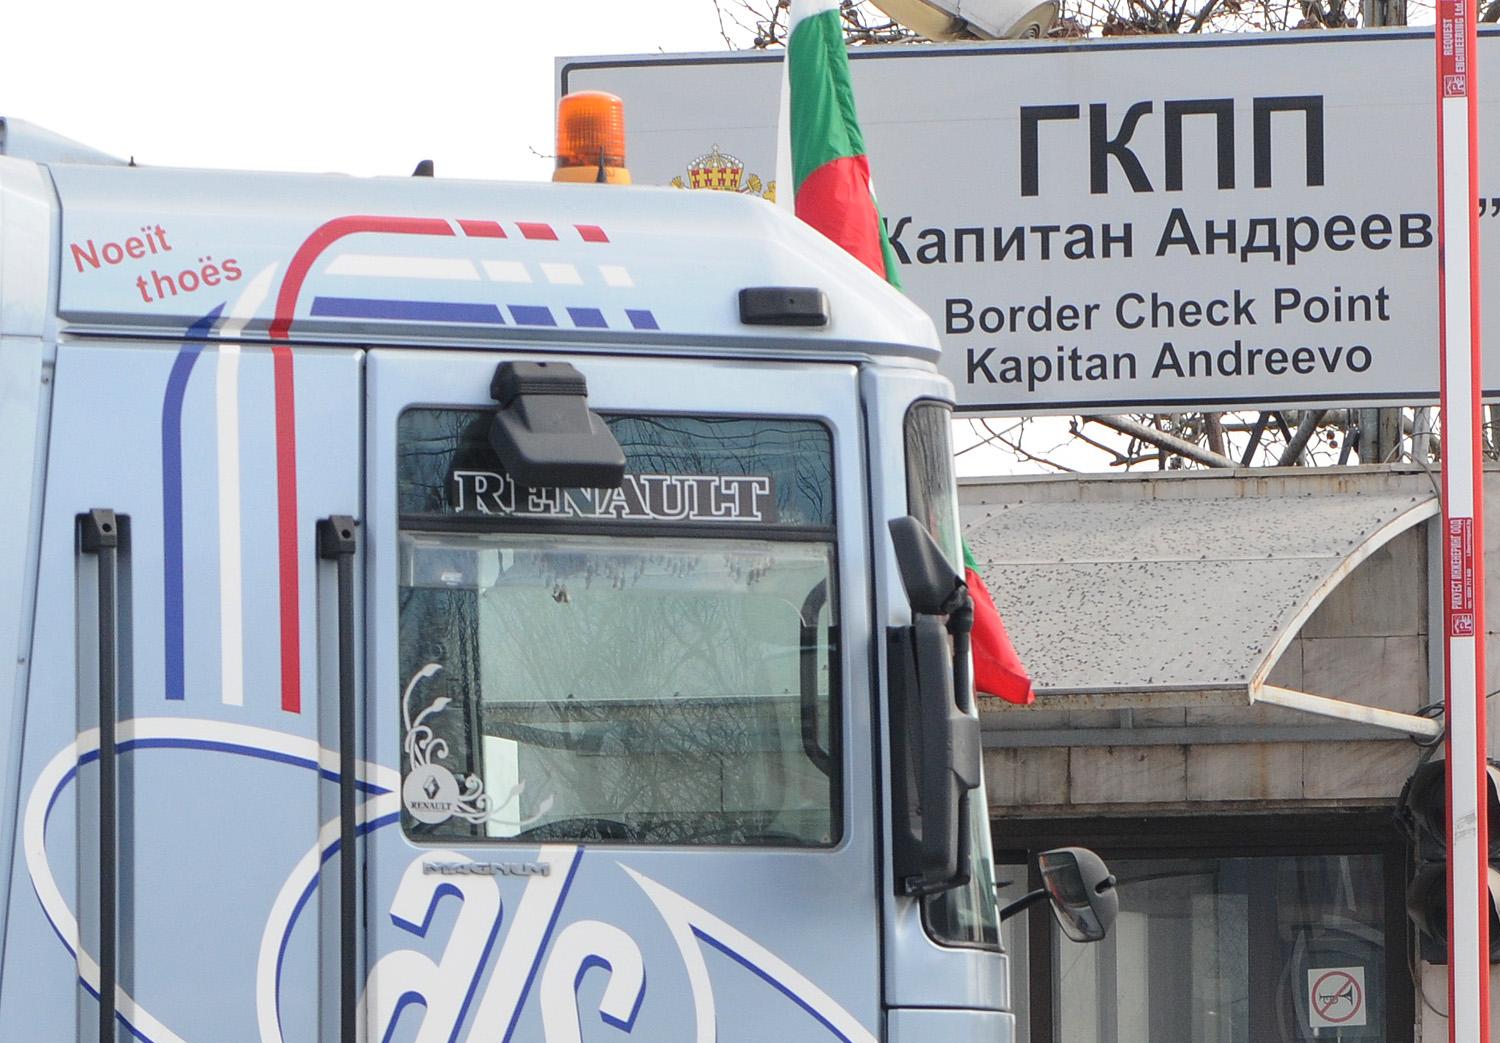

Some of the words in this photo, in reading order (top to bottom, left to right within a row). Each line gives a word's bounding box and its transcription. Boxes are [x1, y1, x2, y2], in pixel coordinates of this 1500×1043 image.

[1443, 18, 1453, 56] REQUEST
[1020, 94, 1325, 197] ГКПП
[70, 224, 172, 273] Noeït
[136, 255, 242, 304] thoës
[945, 296, 1101, 335] Border
[1115, 289, 1257, 330] Check
[1274, 286, 1391, 325] Point
[967, 345, 1137, 393] Kapitan
[1152, 340, 1372, 379] Andreevo
[453, 470, 770, 522] RENAULT
[410, 801, 453, 811] RENAULT
[422, 861, 550, 877] MAGNUM
